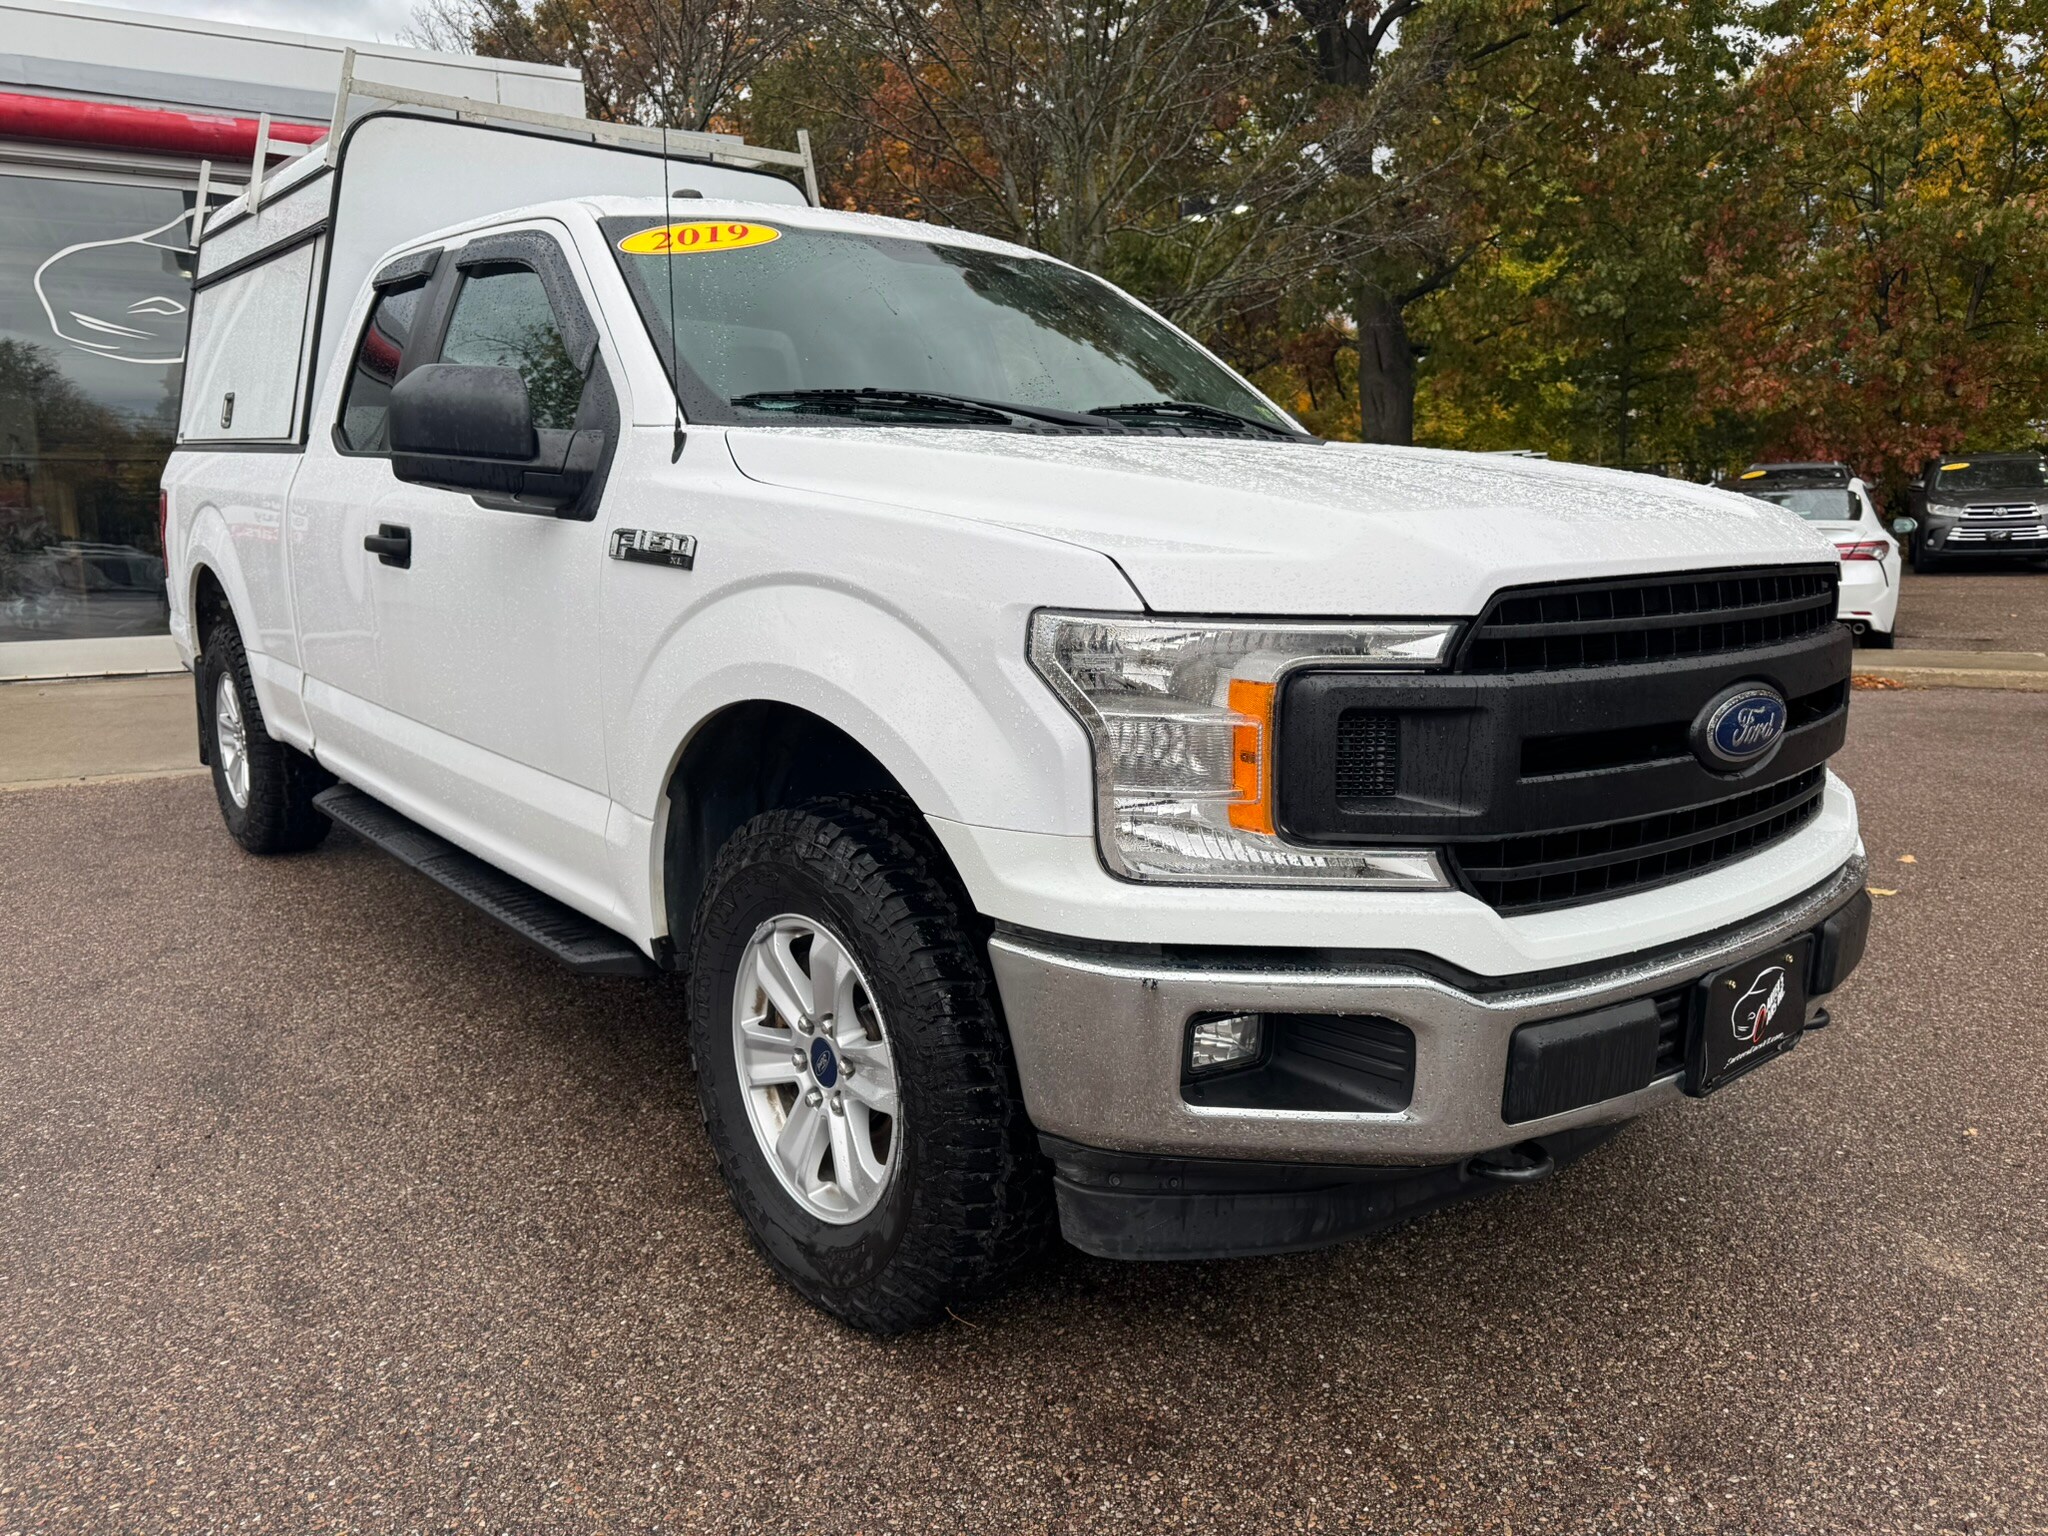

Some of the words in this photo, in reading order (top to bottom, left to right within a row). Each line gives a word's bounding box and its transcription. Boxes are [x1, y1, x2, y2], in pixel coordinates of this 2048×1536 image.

[651, 224, 749, 250] 2019
[669, 556, 683, 566] XL
[1732, 706, 1775, 747] Ford
